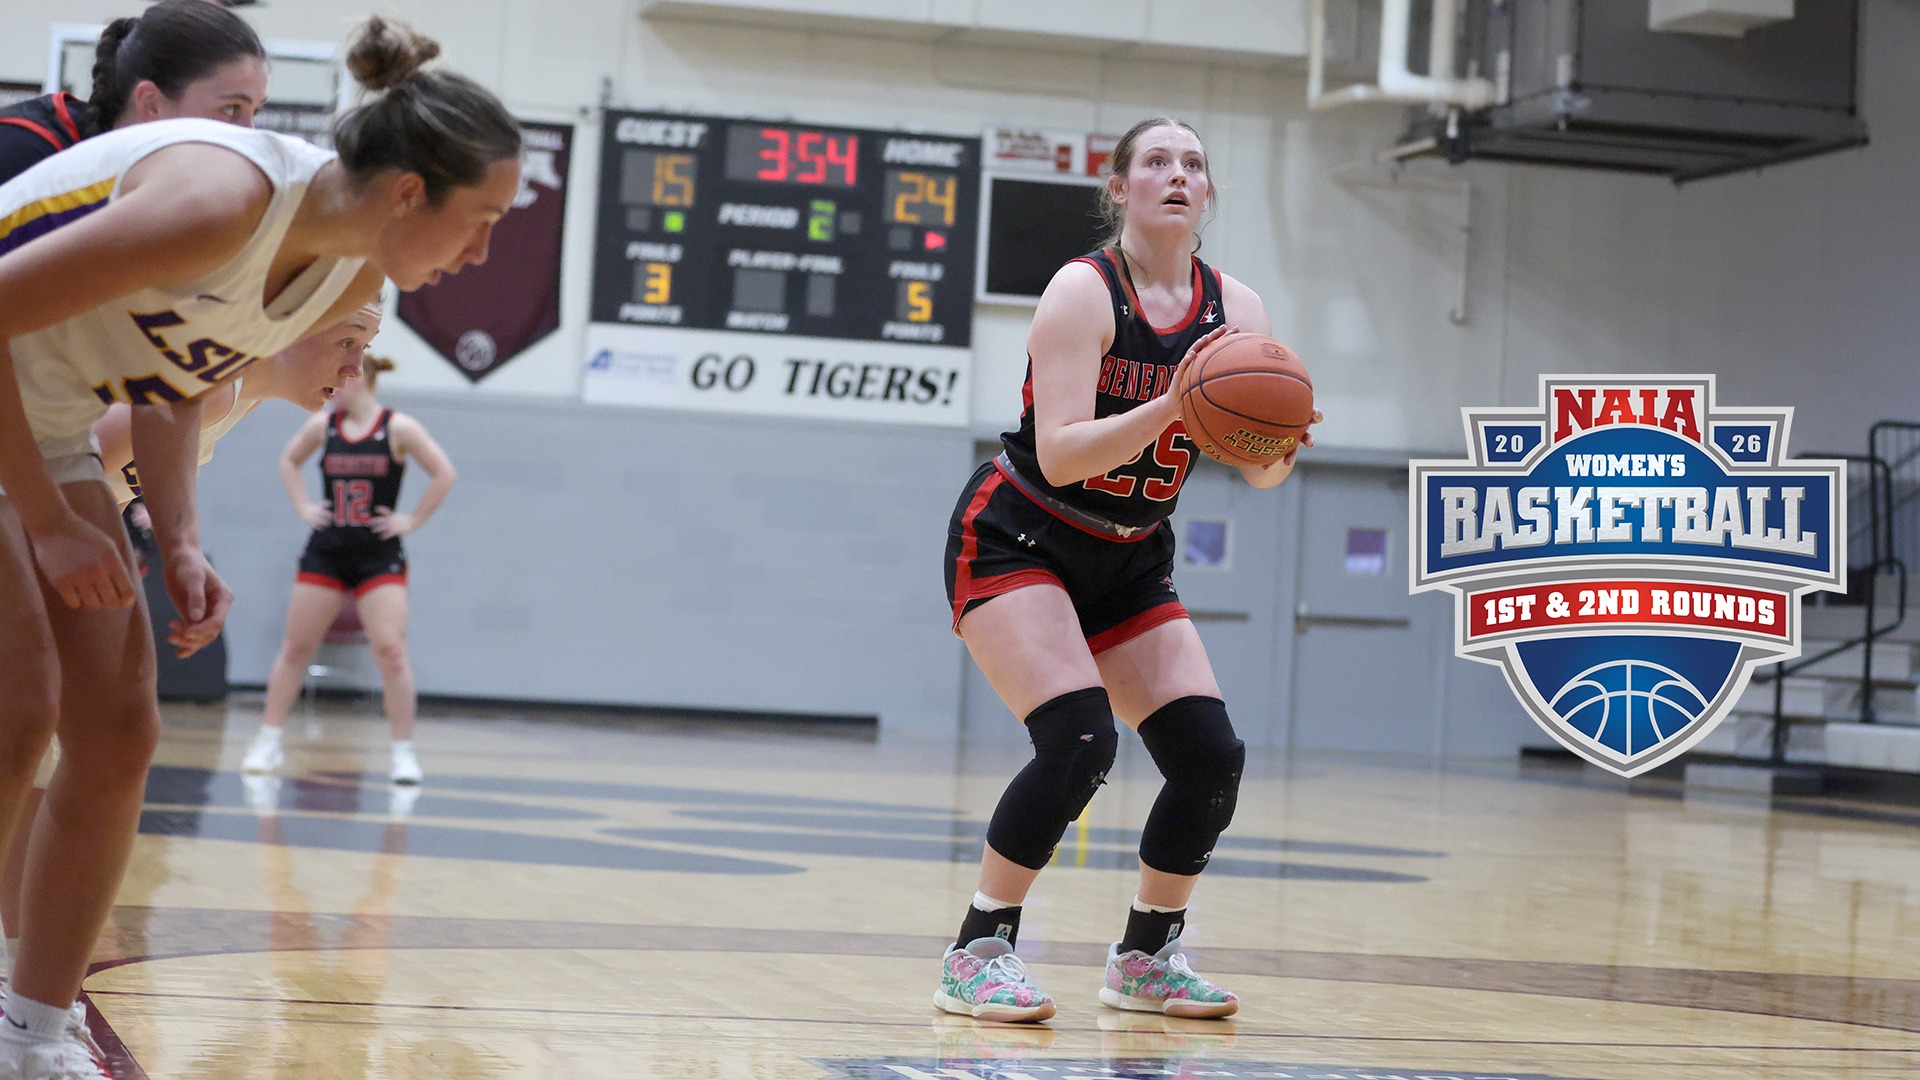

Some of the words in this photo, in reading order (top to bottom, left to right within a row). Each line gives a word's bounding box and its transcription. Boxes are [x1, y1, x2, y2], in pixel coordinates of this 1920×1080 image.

[653, 153, 695, 208] 15
[757, 128, 859, 187] 3:54
[894, 171, 957, 228] 24
[642, 262, 673, 306] 3
[906, 280, 934, 323] 5
[128, 310, 259, 383] LSU
[691, 352, 757, 392] GO
[782, 357, 960, 406] TIGERS!
[1096, 355, 1179, 402] BENEDI
[332, 479, 374, 527] 12
